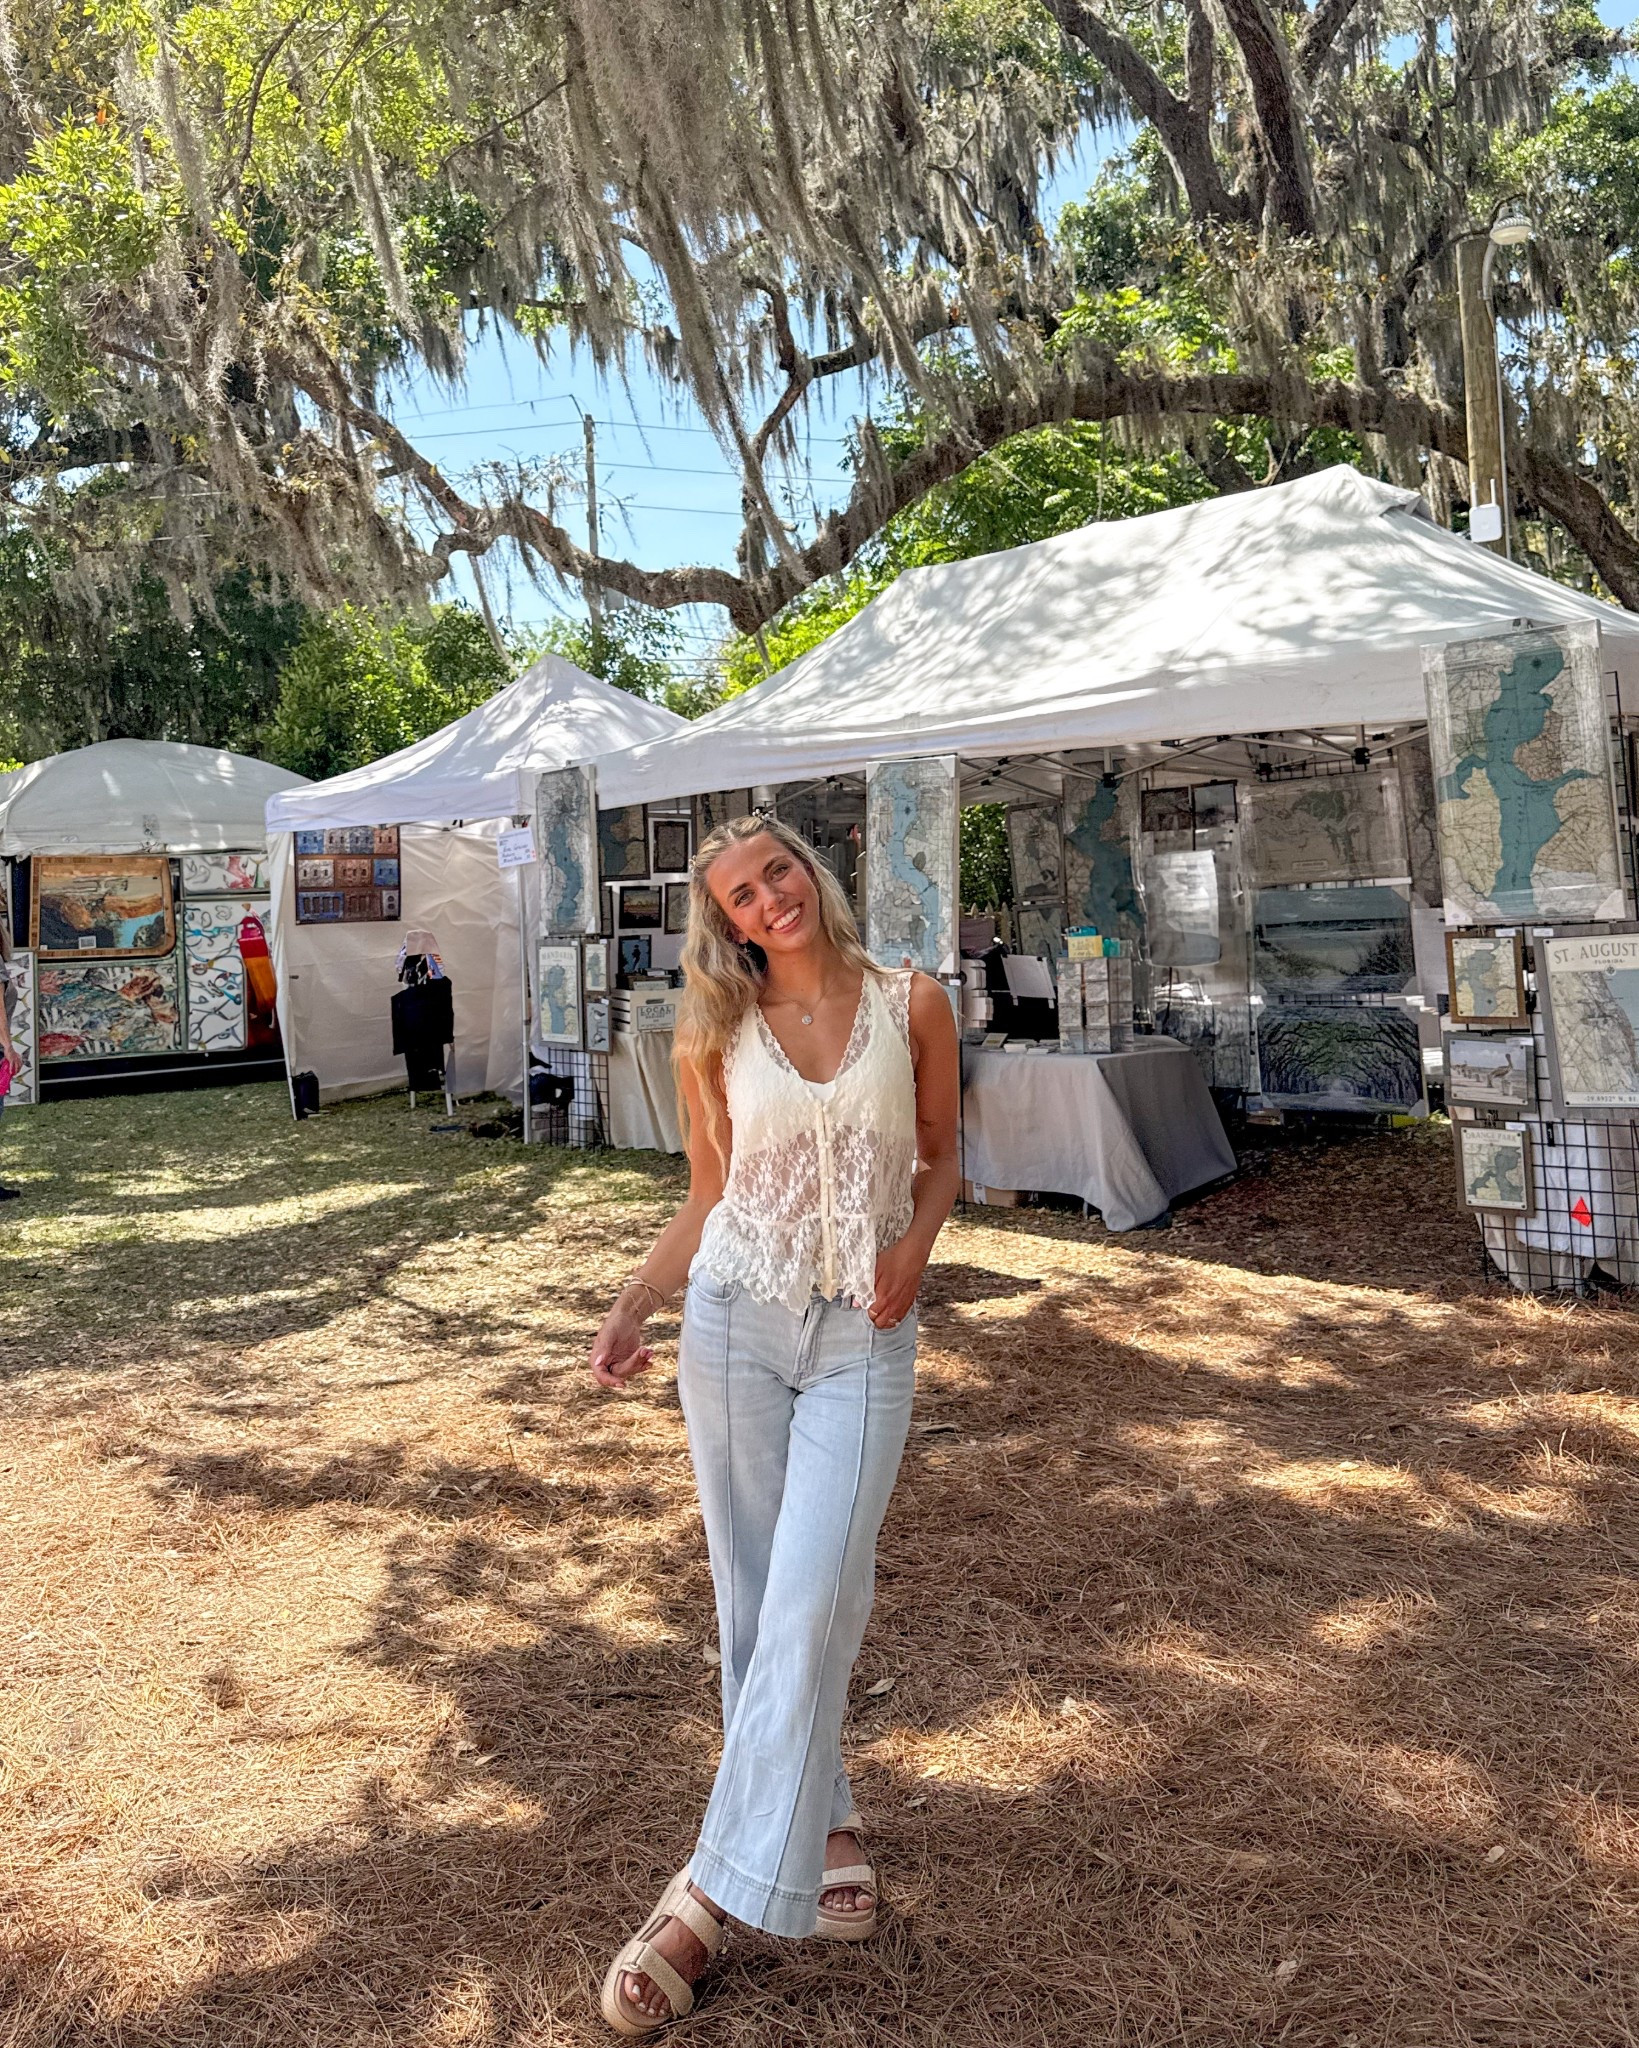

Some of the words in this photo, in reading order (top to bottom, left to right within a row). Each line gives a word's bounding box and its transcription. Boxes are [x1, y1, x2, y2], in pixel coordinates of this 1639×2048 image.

[541, 950, 574, 961] MANDARIN
[1553, 947, 1575, 965] ST.
[640, 1006, 672, 1014] LOCAL
[1465, 1131, 1496, 1140] ORANGE
[1498, 1132, 1517, 1143] PARK
